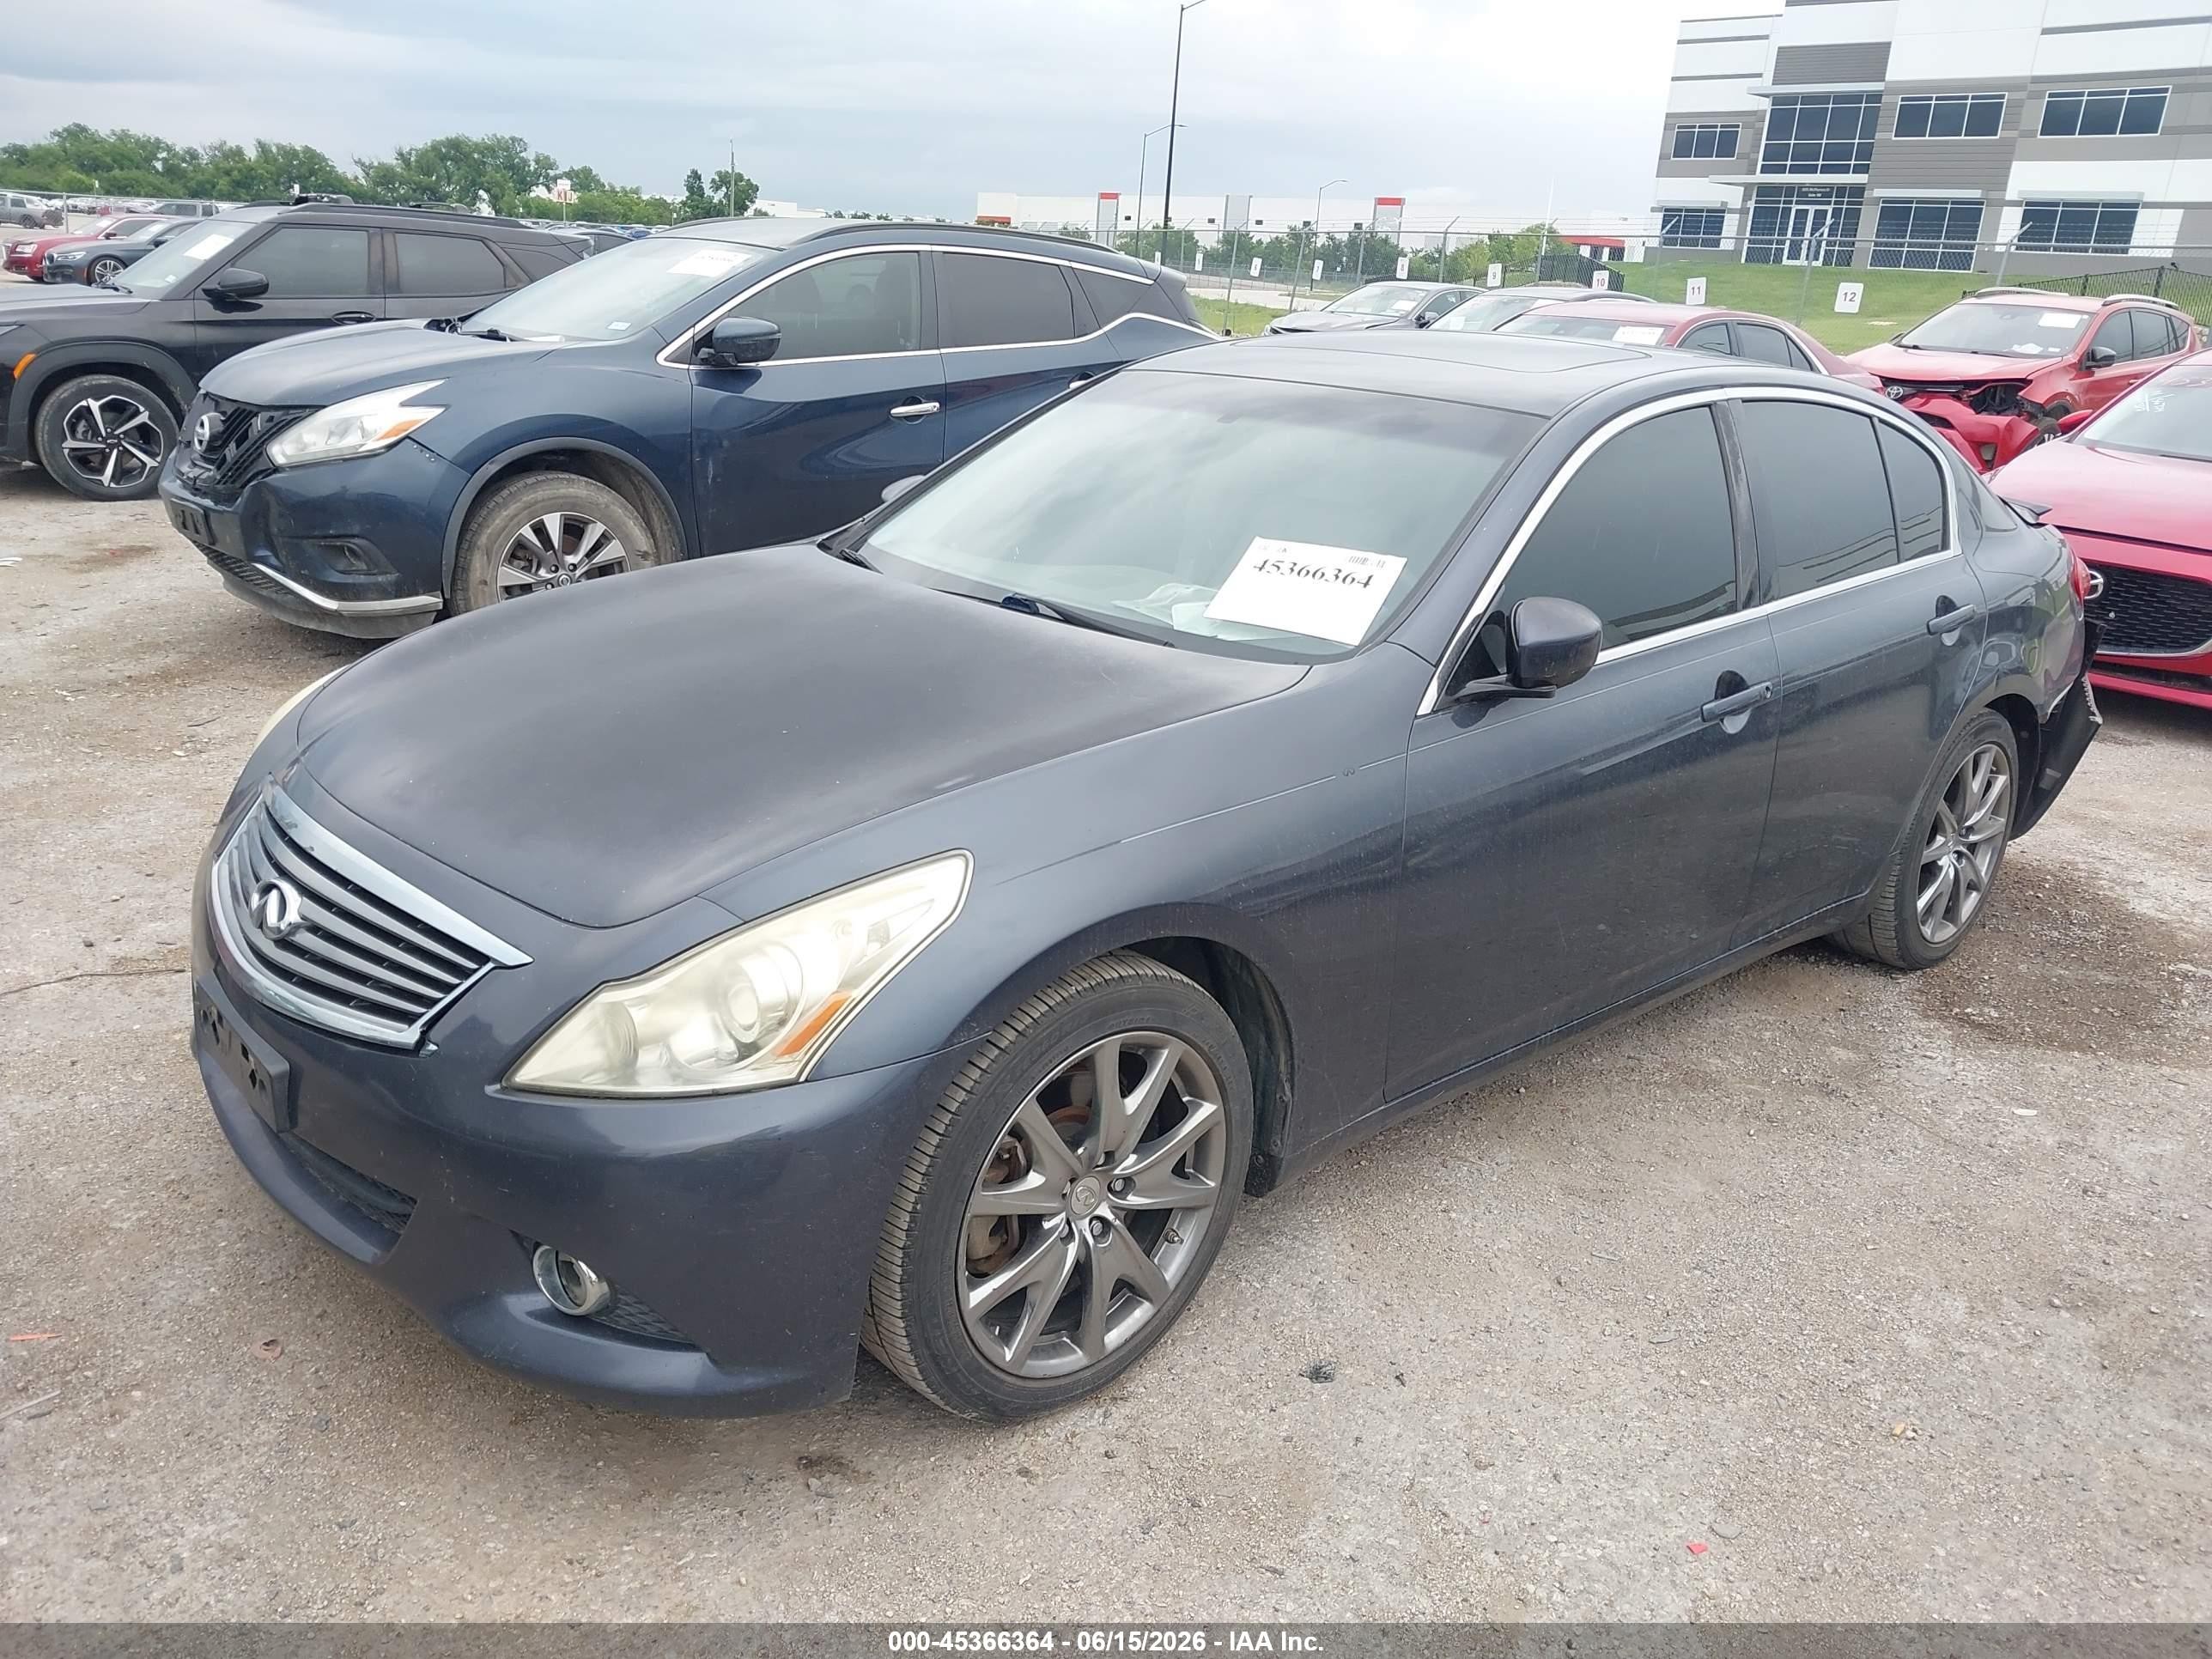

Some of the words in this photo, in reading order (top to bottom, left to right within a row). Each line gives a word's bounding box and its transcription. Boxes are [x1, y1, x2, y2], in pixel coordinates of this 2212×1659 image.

[1596, 277, 1606, 288] 10
[1691, 286, 1702, 296] 11
[1842, 291, 1856, 302] 12
[1253, 558, 1375, 589] 45366364
